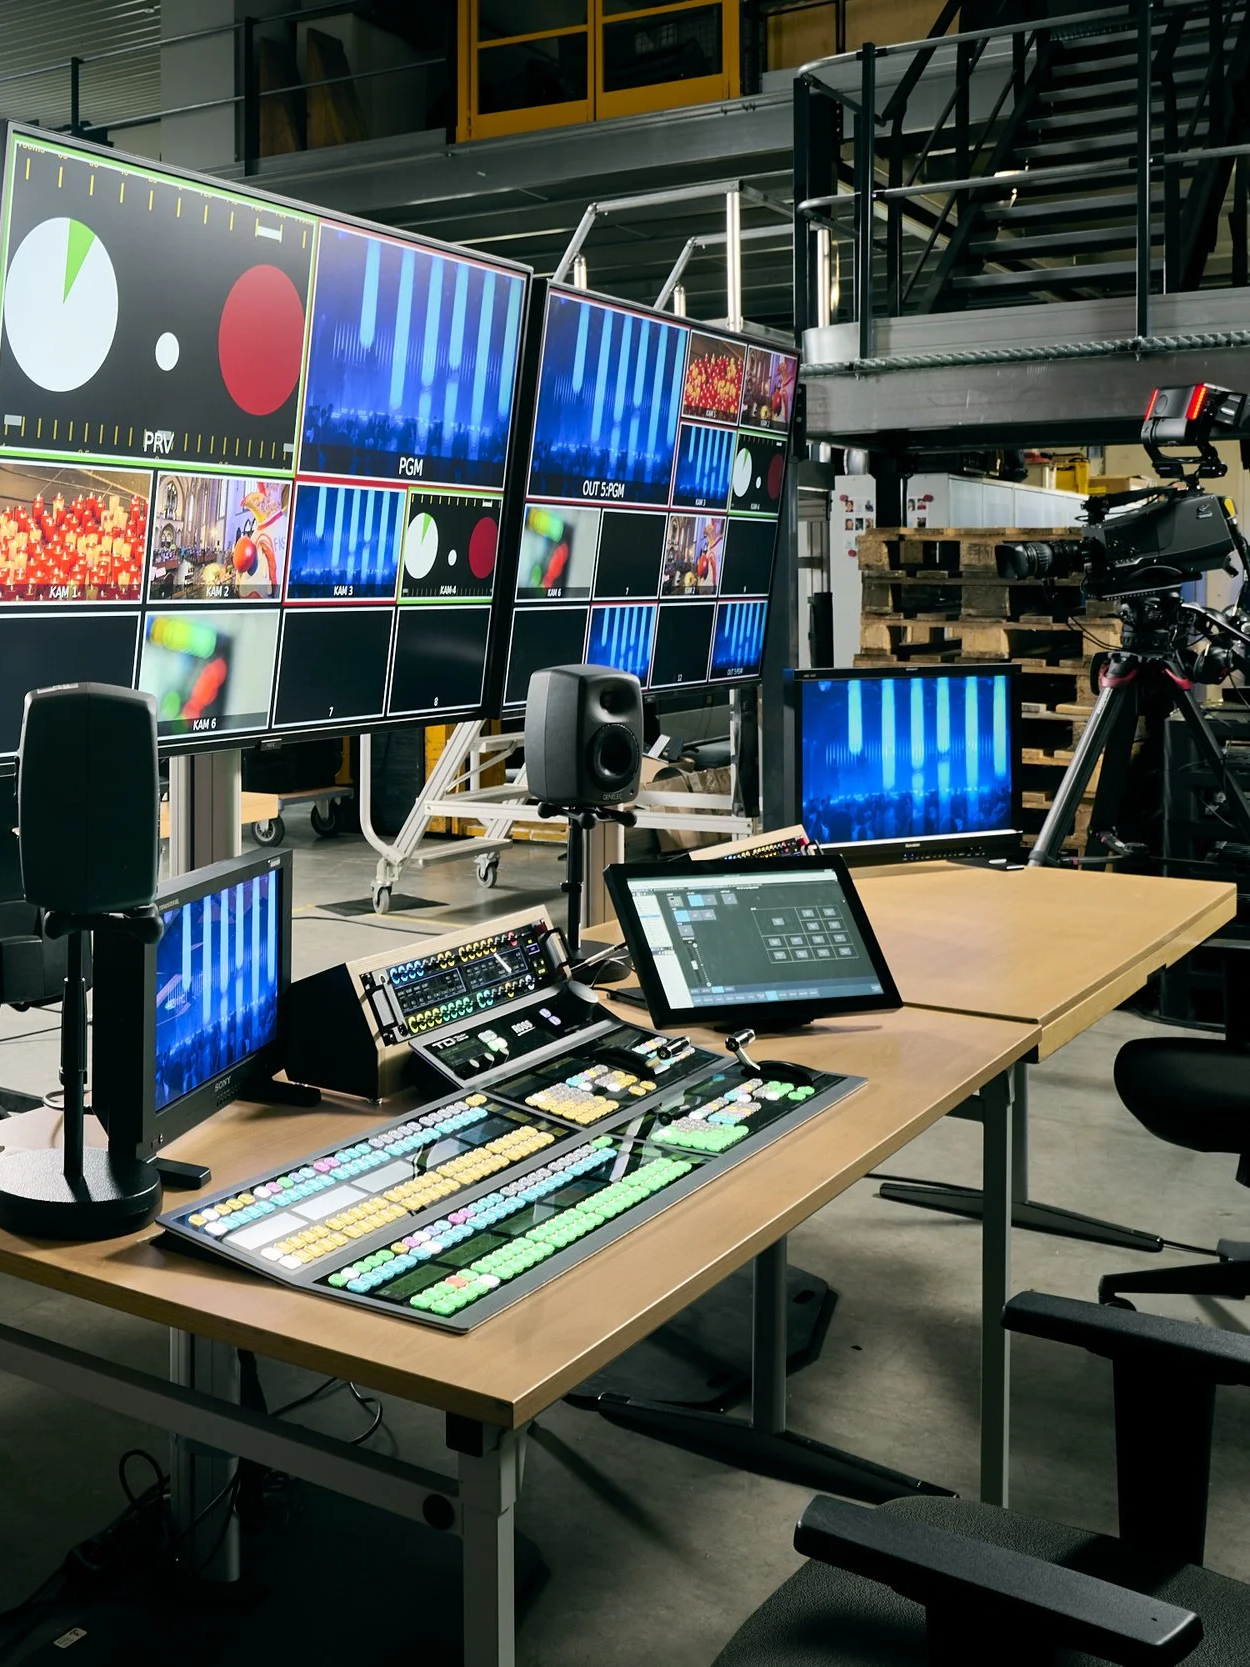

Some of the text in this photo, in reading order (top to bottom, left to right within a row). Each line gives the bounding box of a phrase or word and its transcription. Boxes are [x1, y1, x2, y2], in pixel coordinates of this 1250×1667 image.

[143, 430, 175, 455] PRV
[398, 457, 424, 477] PGM
[582, 479, 625, 498] OUT 5:PGM
[49, 585, 77, 598] KAM 1
[205, 585, 229, 598] KAM 2
[333, 585, 354, 596] KAM 3
[439, 585, 457, 595] KAM 4
[547, 588, 562, 597] KAM 6
[433, 697, 439, 706] 8
[328, 706, 334, 717] 7
[192, 718, 217, 731] KAM 6
[511, 1019, 533, 1034] ROSS
[214, 1075, 232, 1092] SONY
